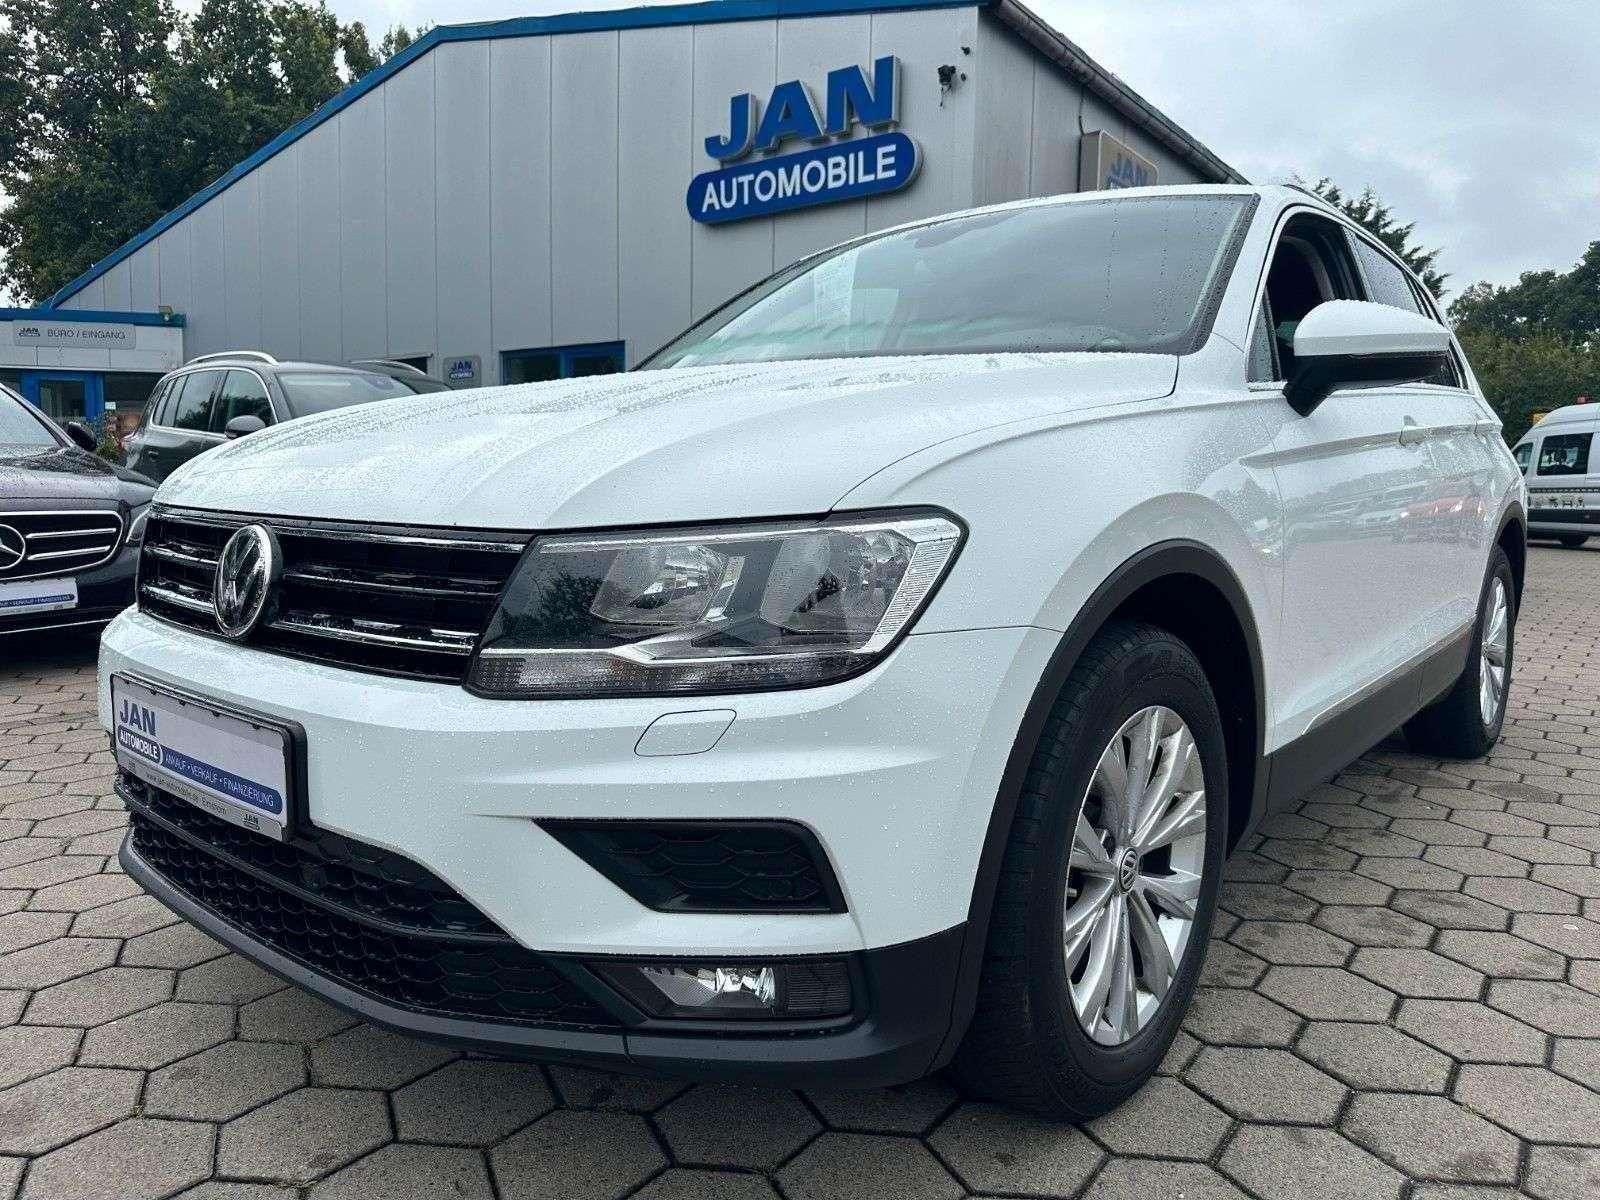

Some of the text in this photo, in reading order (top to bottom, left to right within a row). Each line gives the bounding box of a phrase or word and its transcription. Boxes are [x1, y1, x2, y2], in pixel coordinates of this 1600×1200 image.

[704, 54, 901, 161] JAN
[701, 143, 897, 213] AUTOMOBILE
[82, 329, 126, 340] EINGANG
[452, 360, 472, 371] JAN
[119, 699, 156, 737] JAN
[120, 729, 159, 760] AUTOMOBILE
